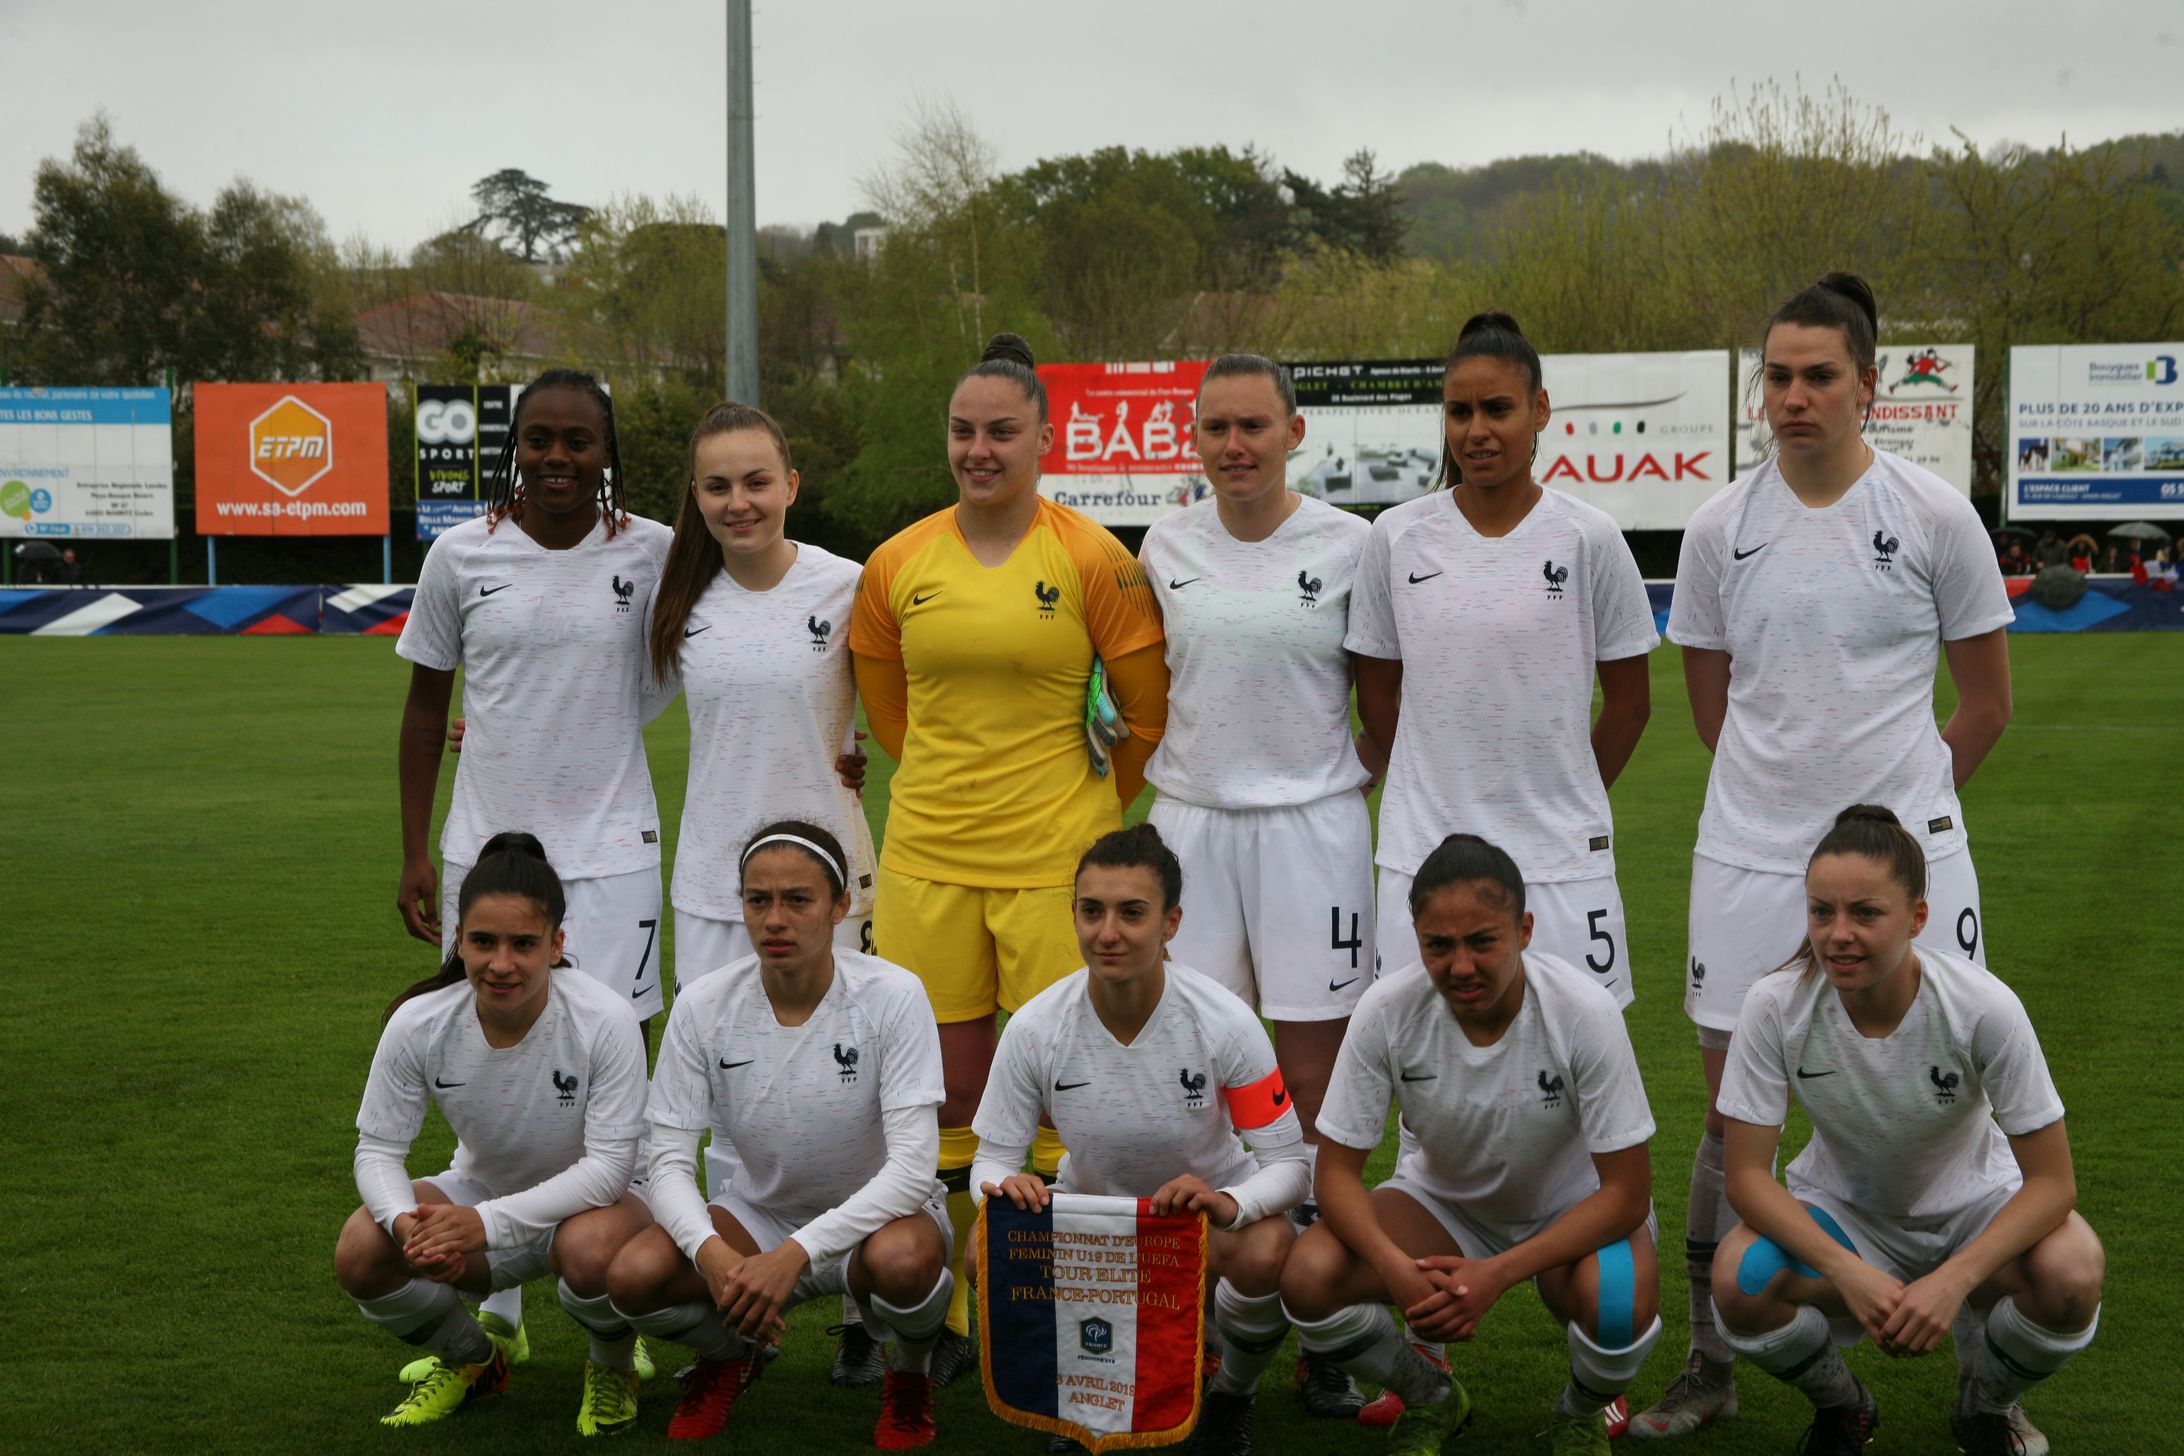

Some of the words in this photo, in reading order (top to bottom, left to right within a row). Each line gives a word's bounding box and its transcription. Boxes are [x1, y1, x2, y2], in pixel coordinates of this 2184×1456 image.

[1293, 366, 1364, 379] PICHET
[2089, 361, 2140, 372] Bouygues
[17, 409, 32, 420] LES
[34, 410, 59, 420] BONS
[60, 410, 93, 421] GESTES
[2019, 402, 2055, 414] PLUS
[2059, 403, 2078, 413] DE
[2082, 402, 2100, 414] 20
[2104, 402, 2136, 413] ANS
[416, 398, 476, 444] GO
[1660, 424, 1714, 435] GROUPE
[2018, 418, 2039, 427] SUR
[2040, 418, 2053, 427] LA
[2056, 415, 2083, 428] CÔTE
[2087, 417, 2127, 428] BASQUE
[2131, 417, 2143, 427] ET
[2146, 416, 2157, 427] LE
[2160, 416, 2181, 427] SUD
[257, 436, 325, 459] ETPM
[419, 448, 474, 460] SPORT
[429, 469, 470, 481] VIVONS
[432, 481, 467, 494] SPORT
[2062, 483, 2091, 493] CLIENT
[1055, 490, 1161, 507] Carrefour
[216, 500, 367, 521] www.sa-etpm.com
[1331, 906, 1362, 969] 4
[1585, 908, 1616, 974] 5
[1957, 907, 1979, 961] 9
[634, 919, 657, 981] 7
[1007, 1230, 1110, 1247] CHAMPIONNAT
[1112, 1234, 1181, 1250] D'EUROPE
[1009, 1248, 1073, 1262] FEMININ
[1076, 1250, 1104, 1264] U19
[1105, 1251, 1125, 1264] DE
[1128, 1252, 1180, 1267] L'UEFA
[1040, 1264, 1093, 1282] TOUR
[1096, 1265, 1151, 1284] ELITE
[1011, 1286, 1181, 1311] FRANCE-PORTUGAL
[1085, 1341, 1109, 1349] FRANCE
[1066, 1375, 1108, 1391] AVRIL
[1109, 1381, 1136, 1397] 2019
[1068, 1391, 1126, 1412] ANGLET
